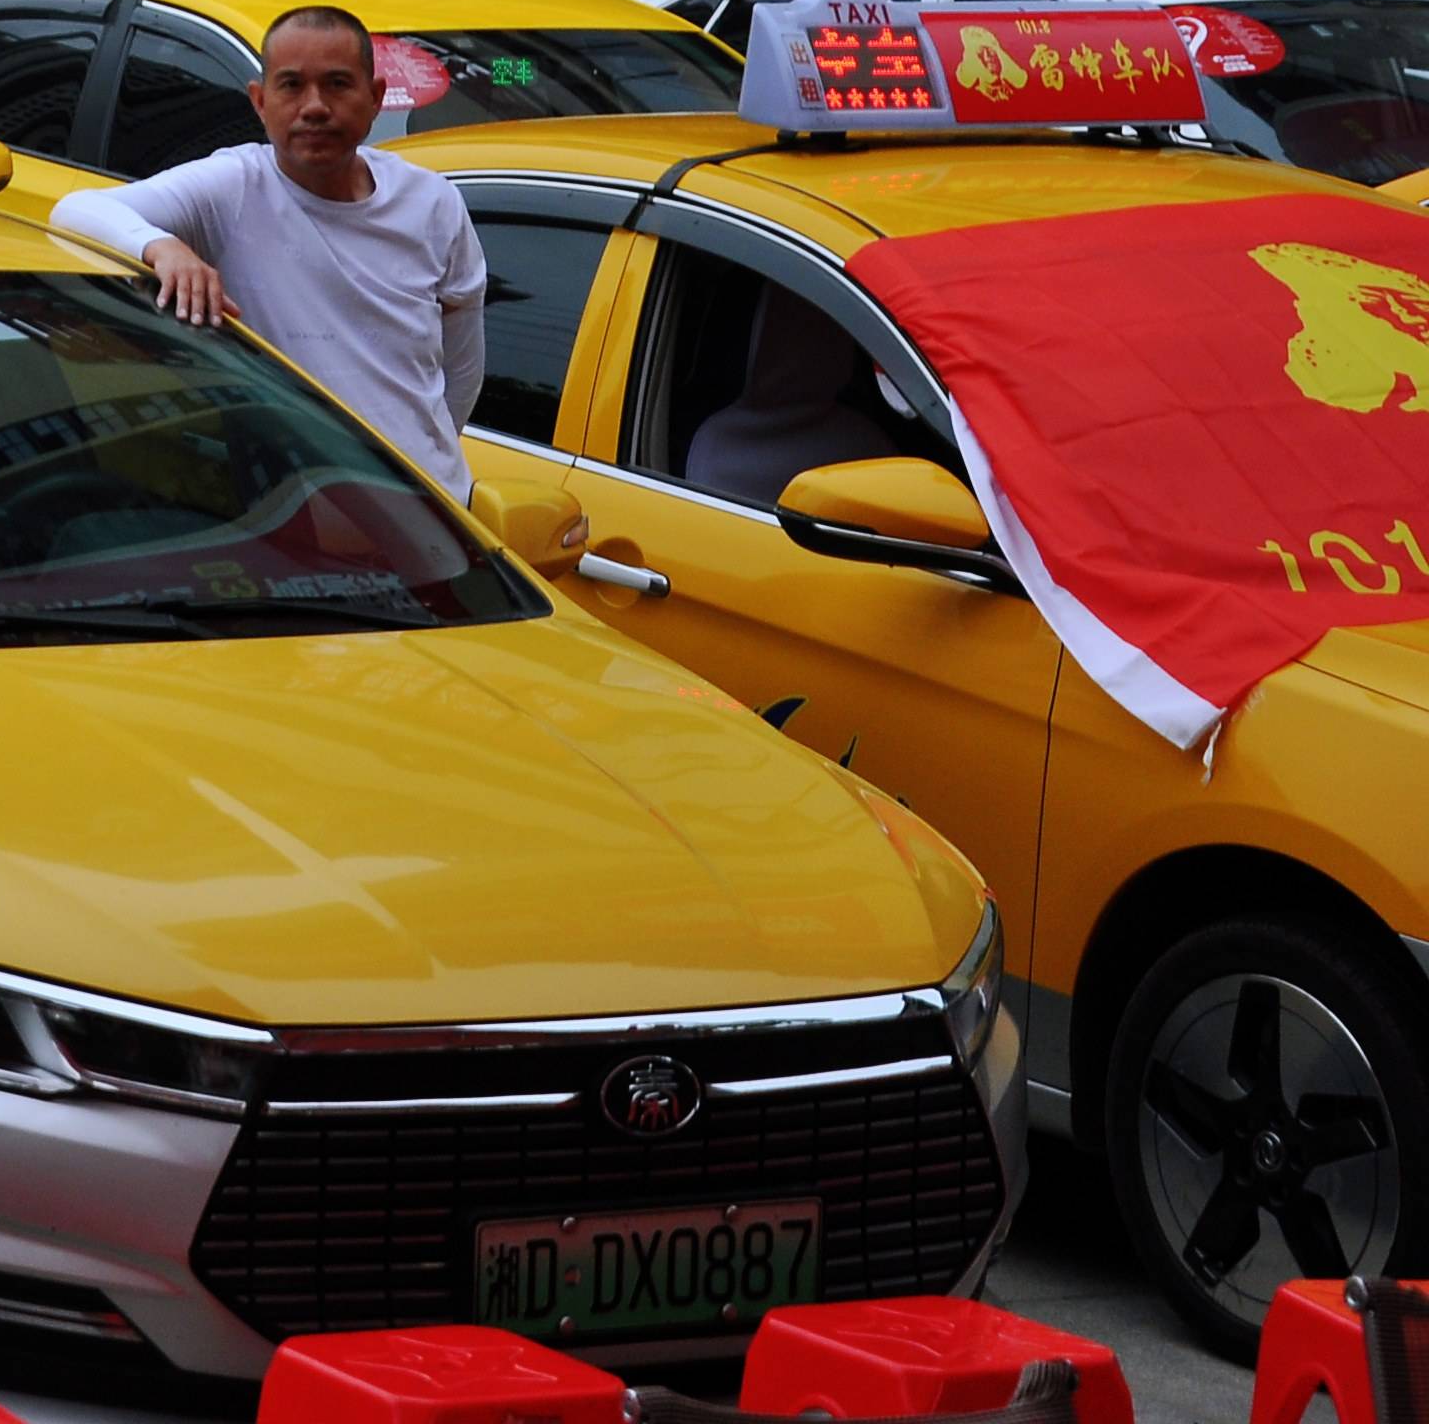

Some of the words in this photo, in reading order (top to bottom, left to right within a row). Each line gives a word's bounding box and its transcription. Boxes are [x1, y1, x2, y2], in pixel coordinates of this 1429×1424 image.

[827, 1, 891, 25] TAXI
[1014, 18, 1052, 35] 101.8
[1027, 39, 1186, 96] 雷锋车队
